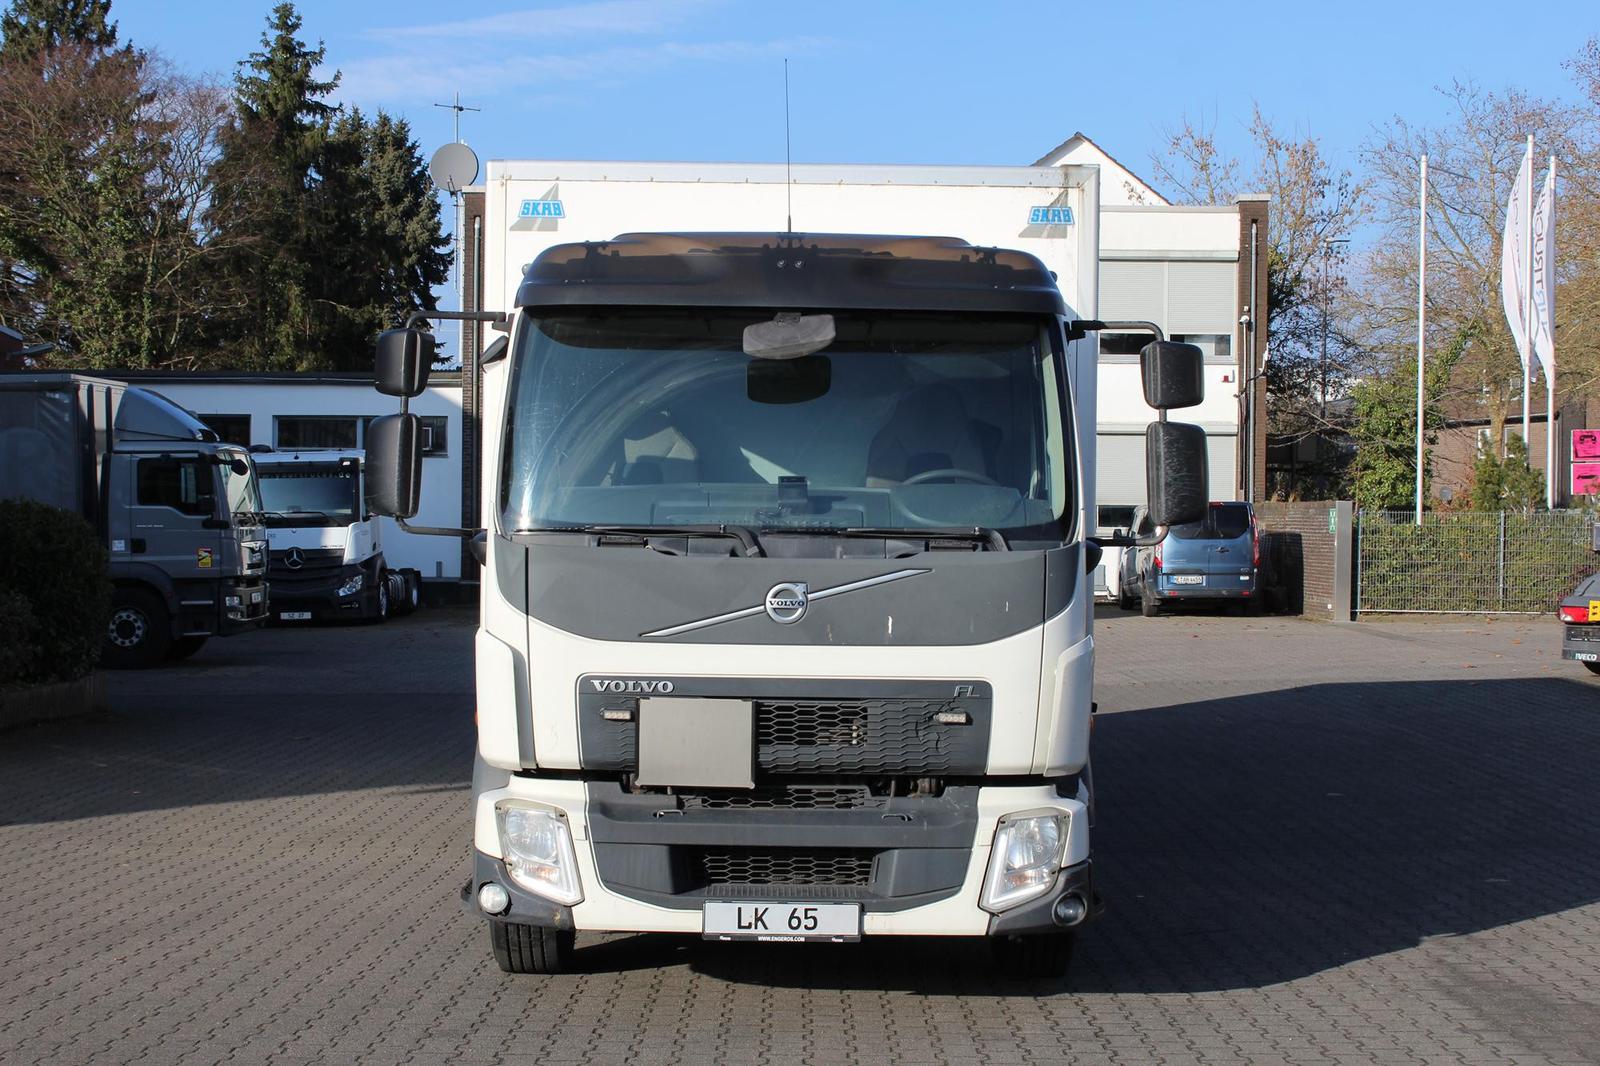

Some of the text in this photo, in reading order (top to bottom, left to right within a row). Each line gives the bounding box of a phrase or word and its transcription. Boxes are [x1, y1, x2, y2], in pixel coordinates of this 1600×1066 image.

[521, 202, 562, 216] SKAB
[1031, 208, 1072, 222] SKAB
[1575, 653, 1597, 661] IVECO
[590, 680, 674, 693] VOLVO
[954, 685, 980, 697] FL
[737, 907, 818, 930] LK 65
